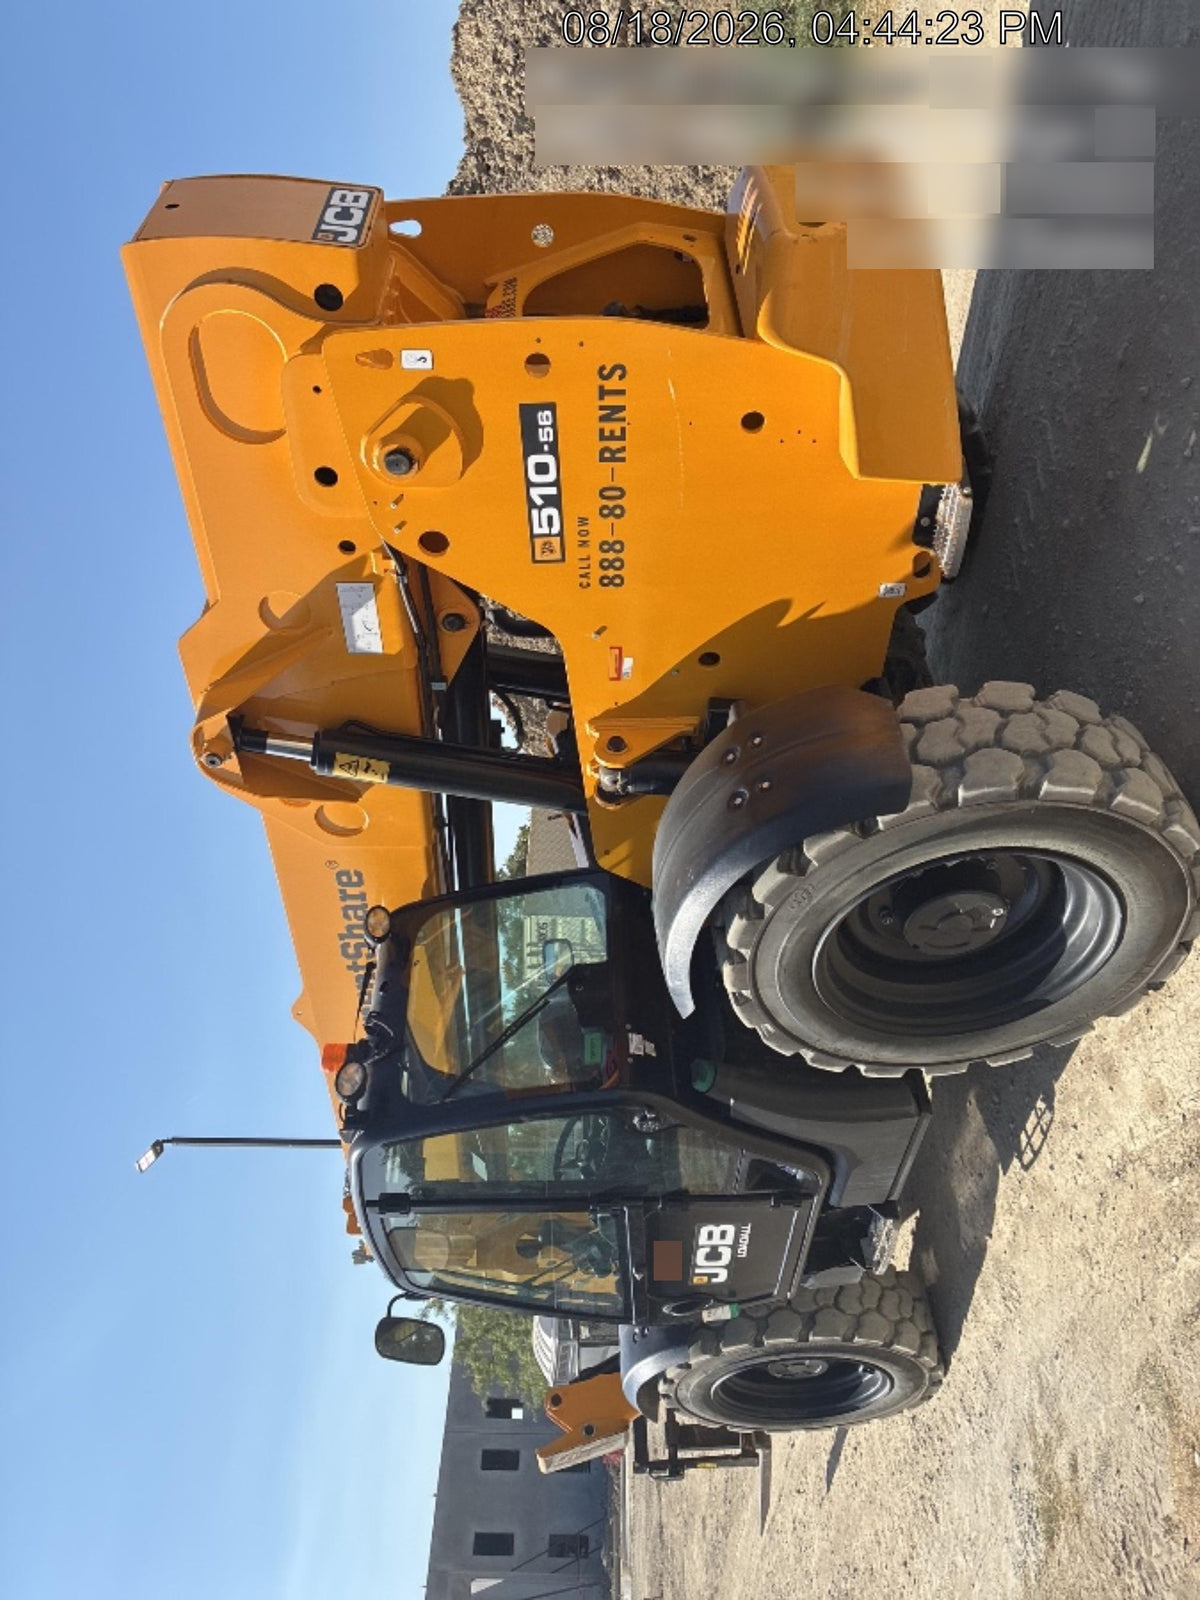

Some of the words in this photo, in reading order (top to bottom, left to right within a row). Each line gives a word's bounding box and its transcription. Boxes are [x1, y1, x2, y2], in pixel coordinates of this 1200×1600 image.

[320, 189, 371, 243] JCB
[527, 410, 561, 536] 510-56
[598, 363, 627, 588] 888-80-RENTS
[577, 516, 590, 548] NOW
[578, 554, 591, 590] CALL
[694, 1224, 735, 1283] JCB
[737, 1222, 752, 1258] LOADALL
